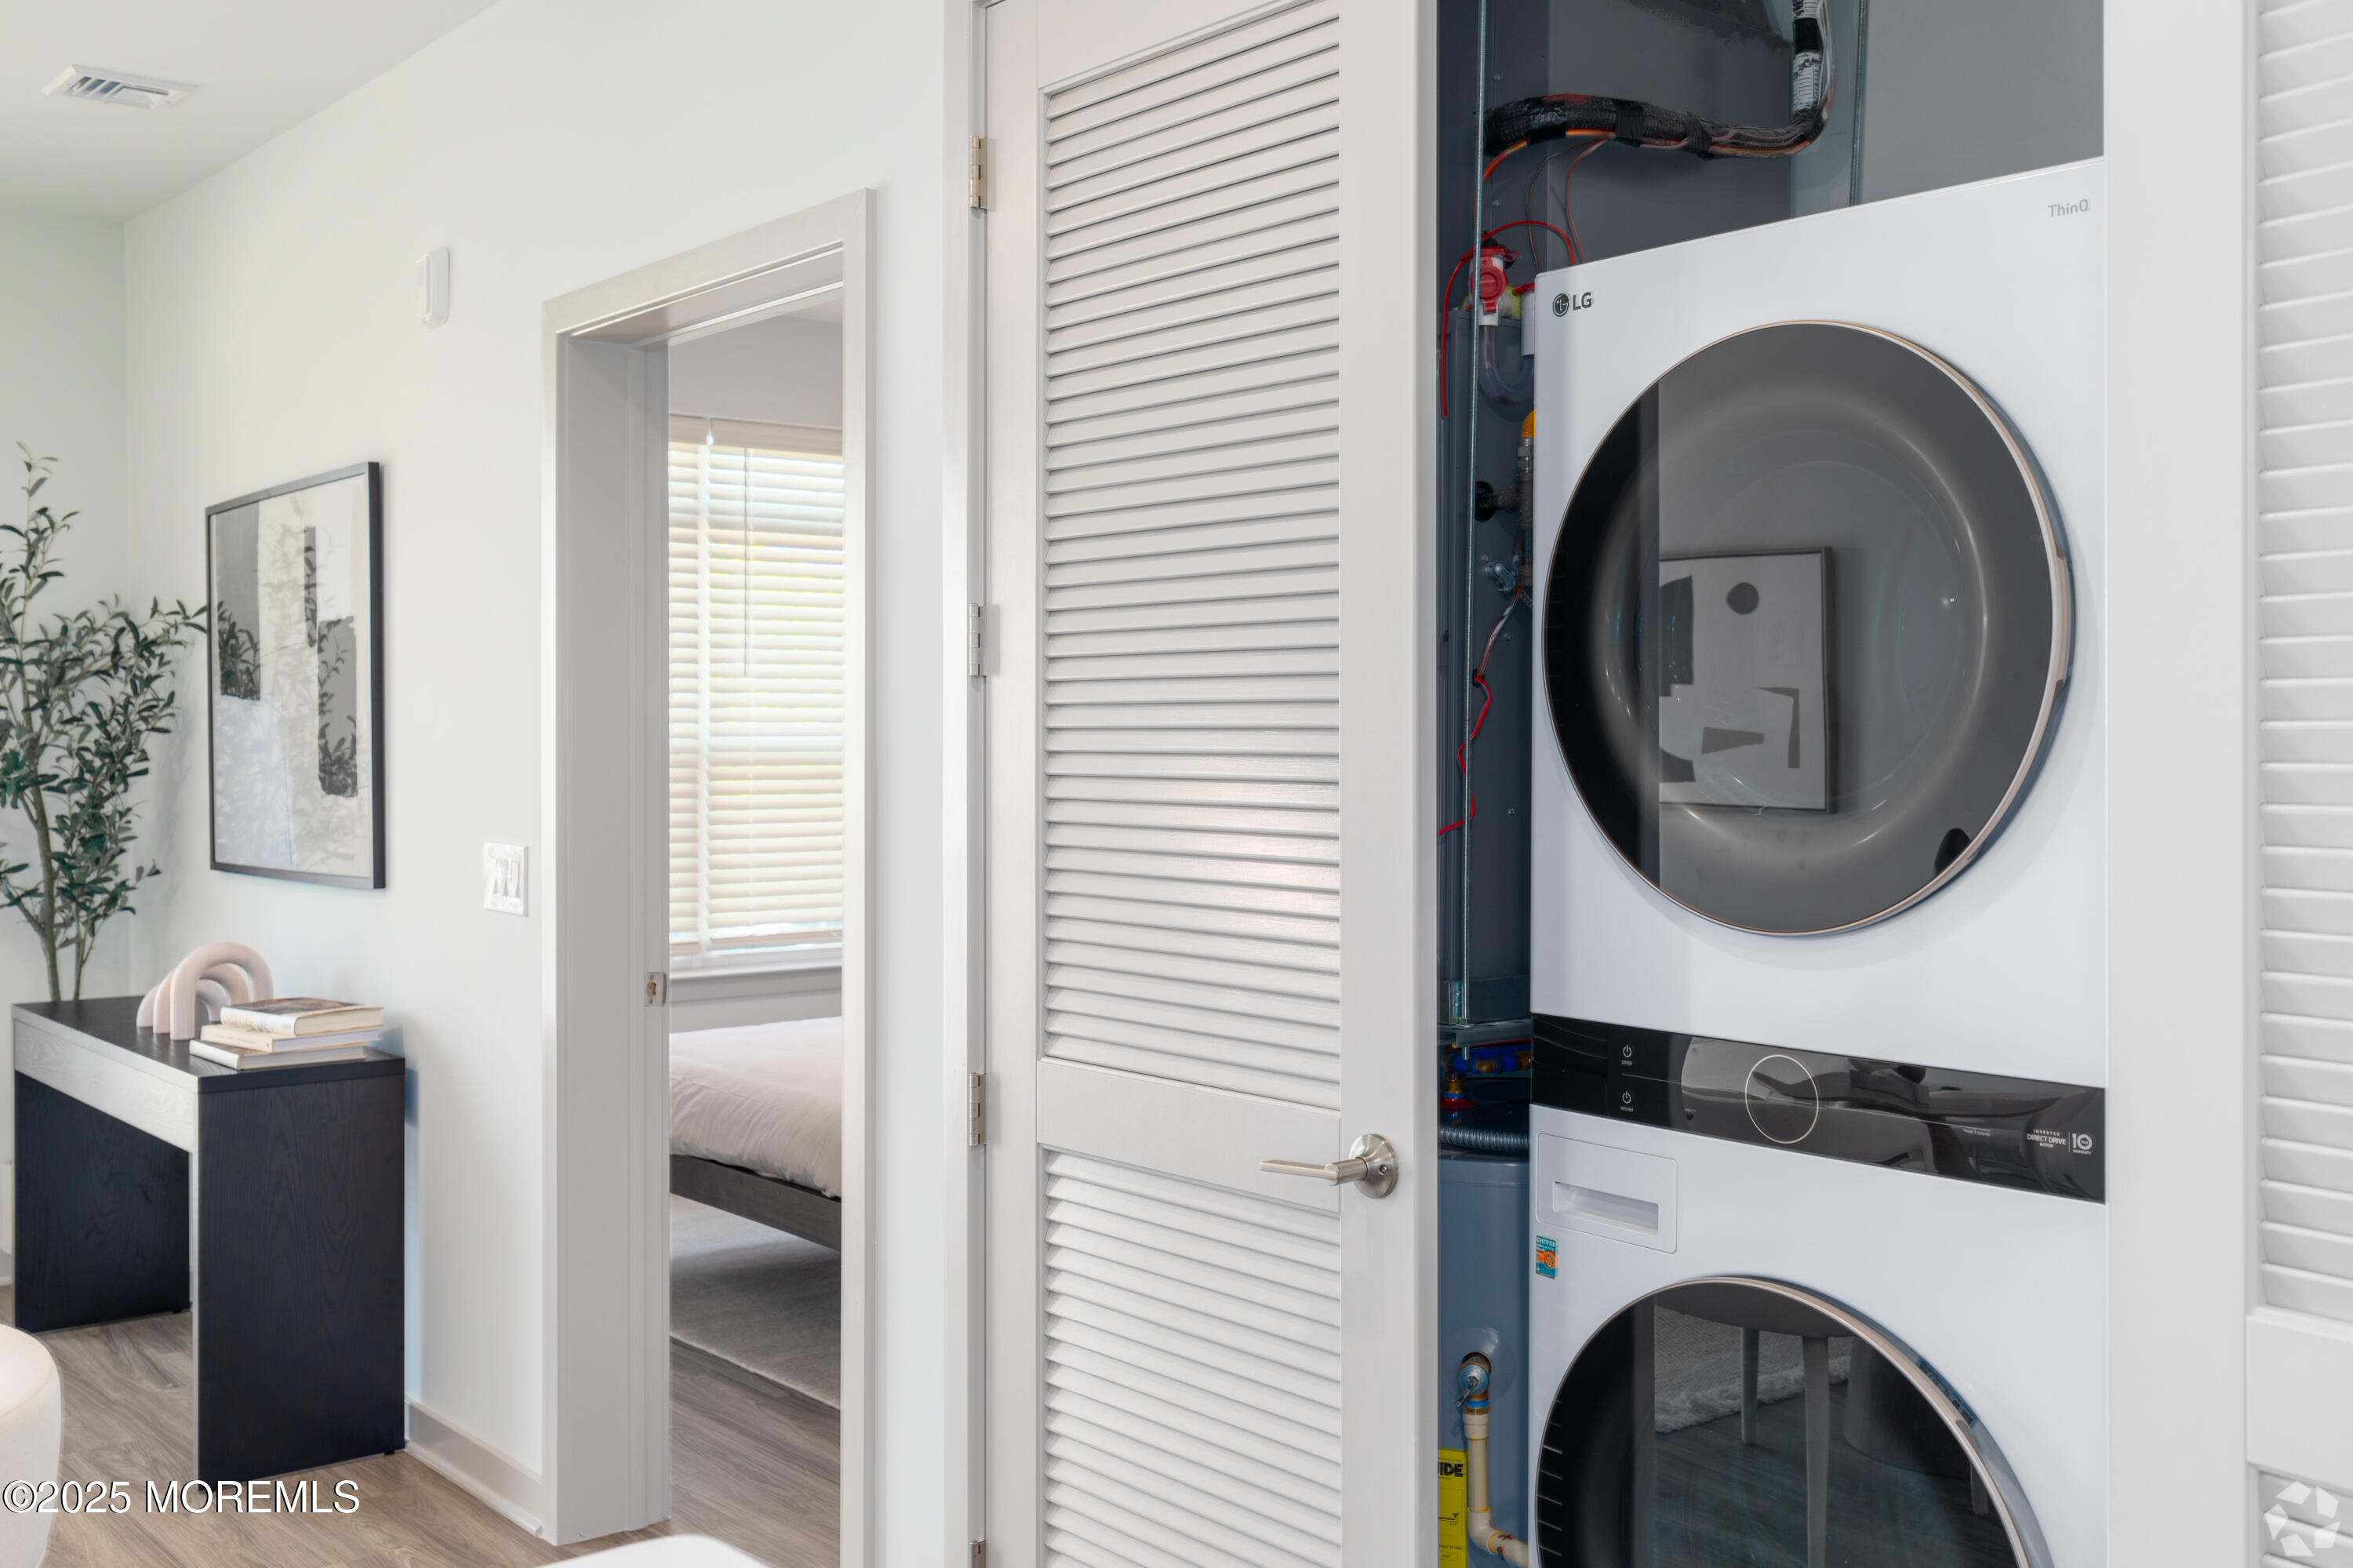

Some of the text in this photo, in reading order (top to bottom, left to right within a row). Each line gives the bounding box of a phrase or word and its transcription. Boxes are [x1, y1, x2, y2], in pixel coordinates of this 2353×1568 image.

[2047, 198, 2090, 217] ThinQ
[1573, 292, 1592, 311] LG
[2027, 1133, 2067, 1145] DIRECT DRIVE
